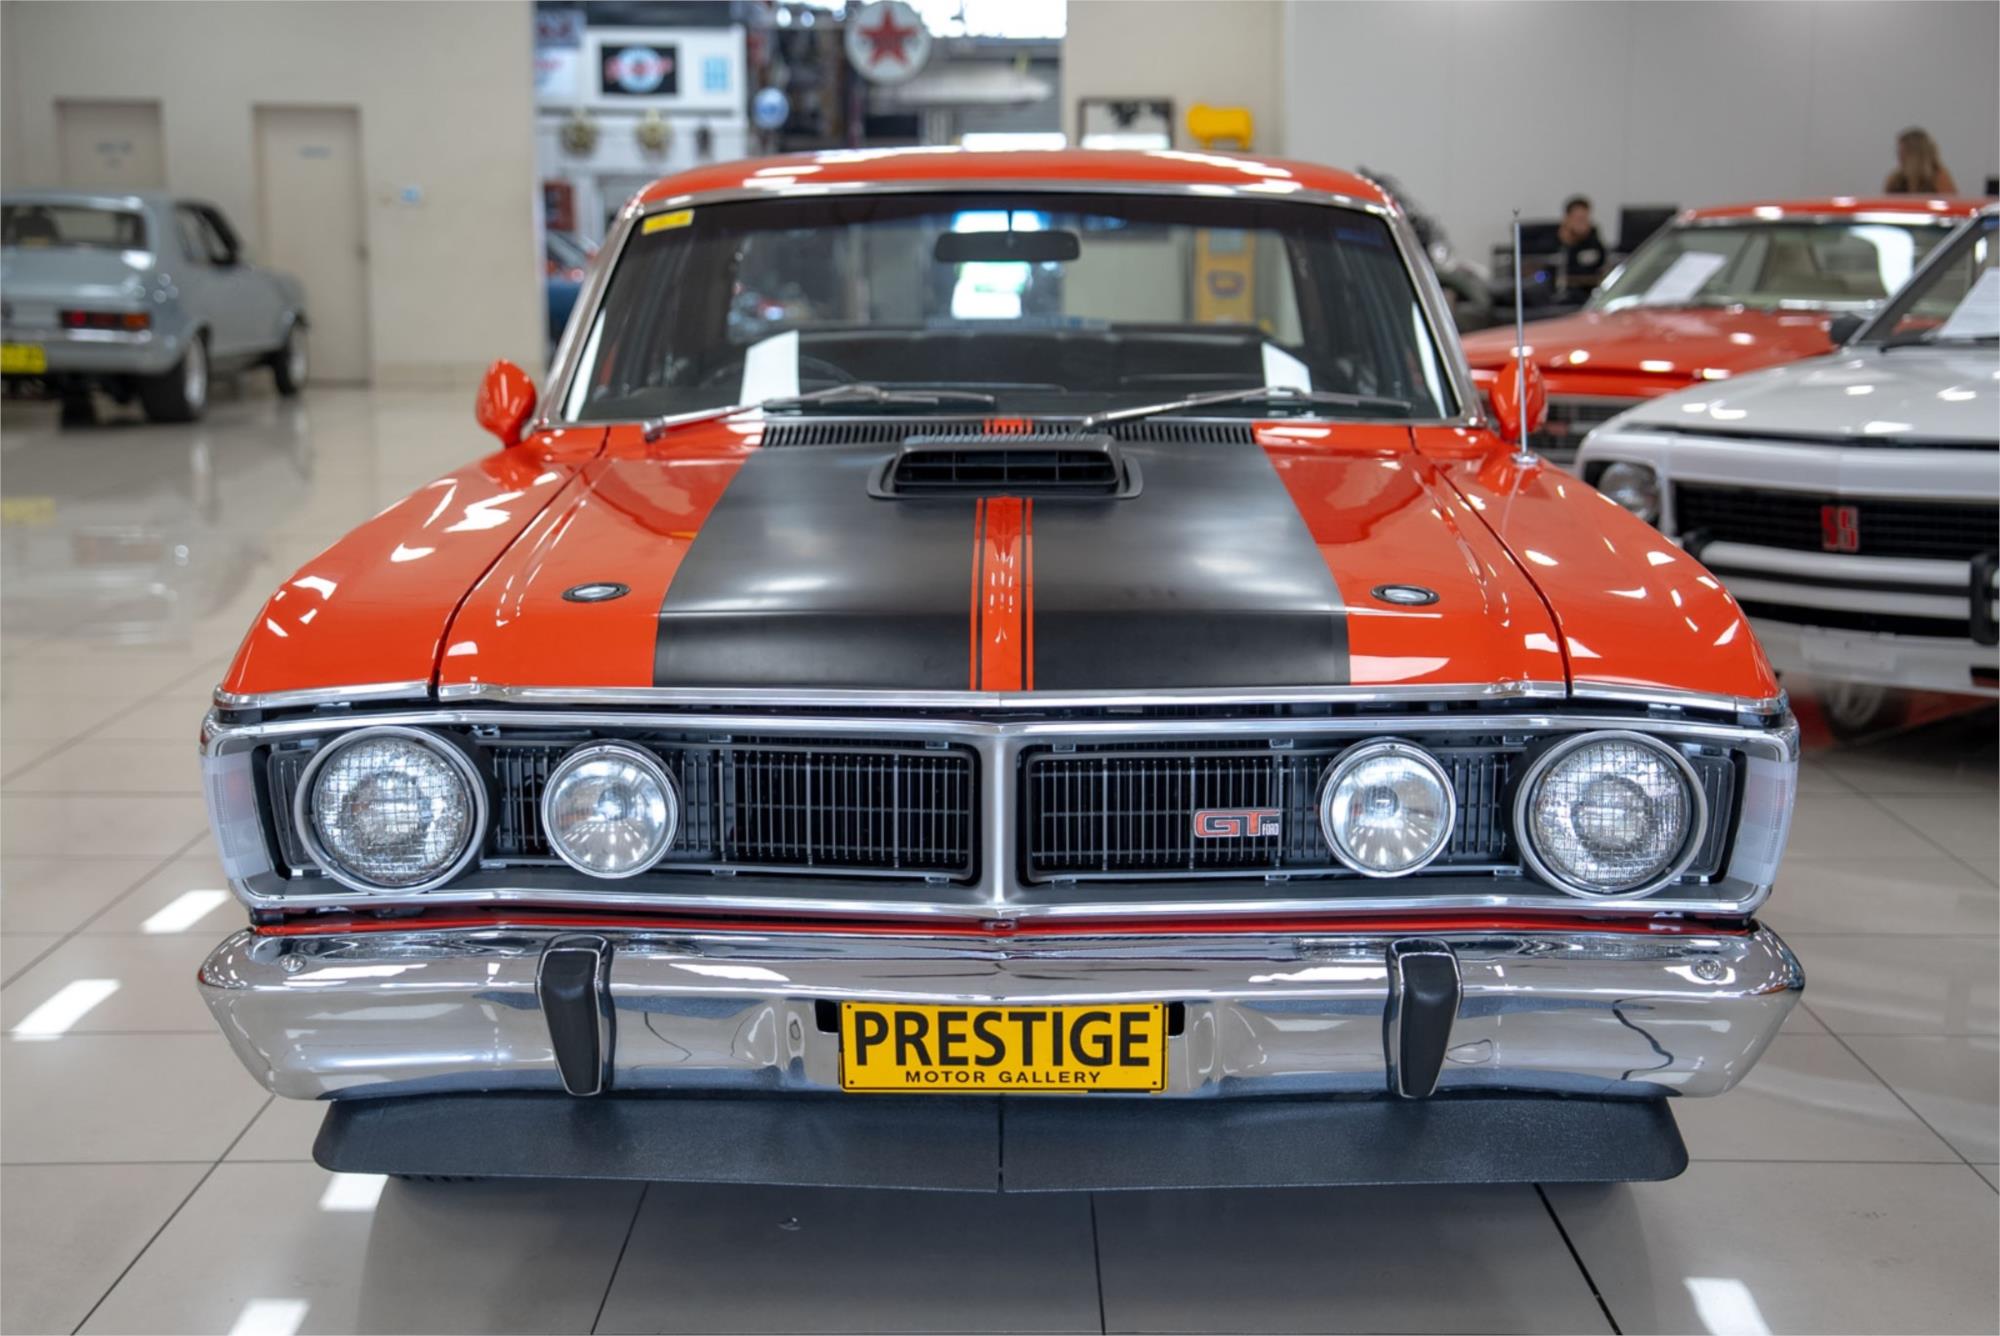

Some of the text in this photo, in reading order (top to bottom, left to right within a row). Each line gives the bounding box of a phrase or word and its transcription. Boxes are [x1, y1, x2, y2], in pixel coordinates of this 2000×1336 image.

[1194, 808, 1280, 838] GT
[854, 1010, 1150, 1067] PRESTIGE
[905, 1070, 1101, 1084] MOTOR GALLERY
